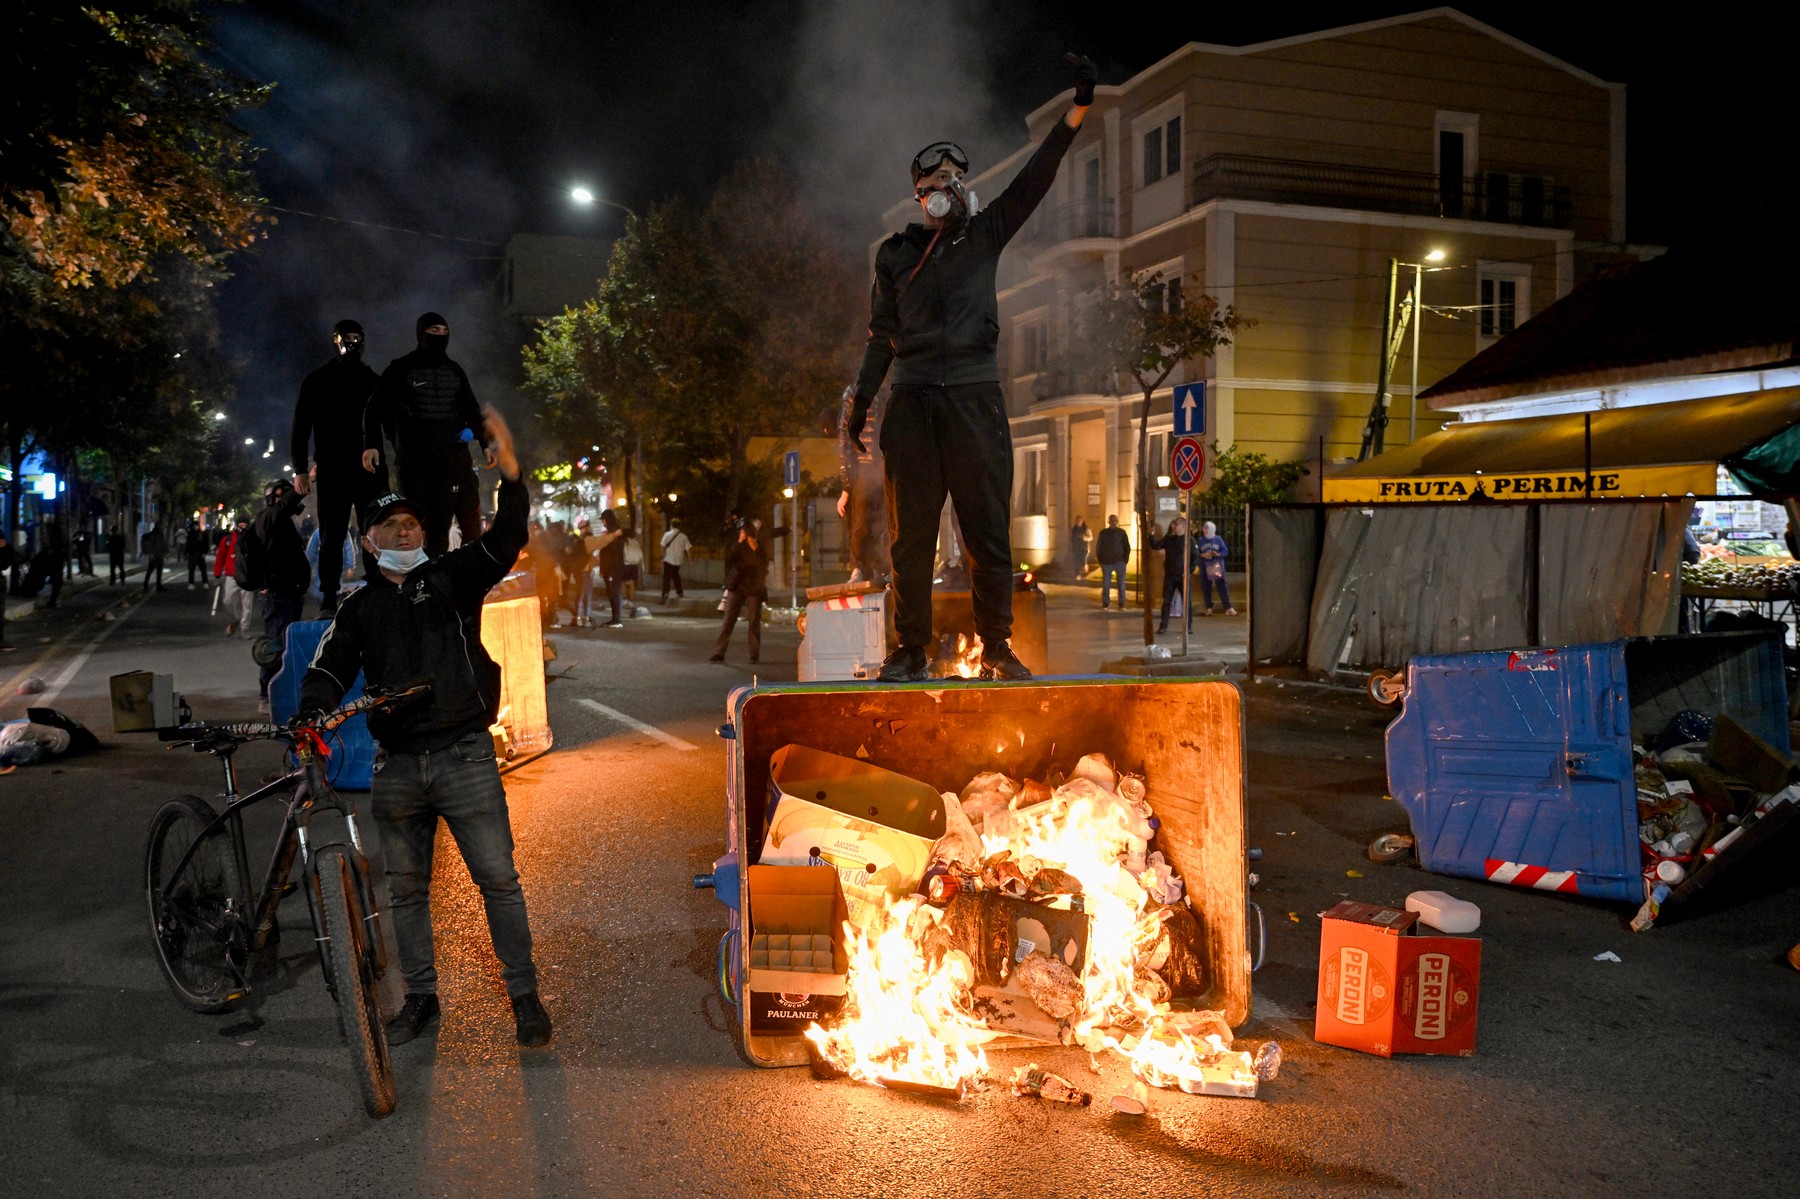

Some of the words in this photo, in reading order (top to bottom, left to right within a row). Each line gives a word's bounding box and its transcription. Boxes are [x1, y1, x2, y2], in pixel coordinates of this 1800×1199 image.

[1380, 481, 1467, 496] FRUTA
[1493, 474, 1619, 493] PERIME
[834, 844, 860, 853] PREMIUM
[1343, 950, 1363, 1021] PERONI
[1421, 957, 1443, 1036] PERONI
[767, 1010, 818, 1019] PAULANER
